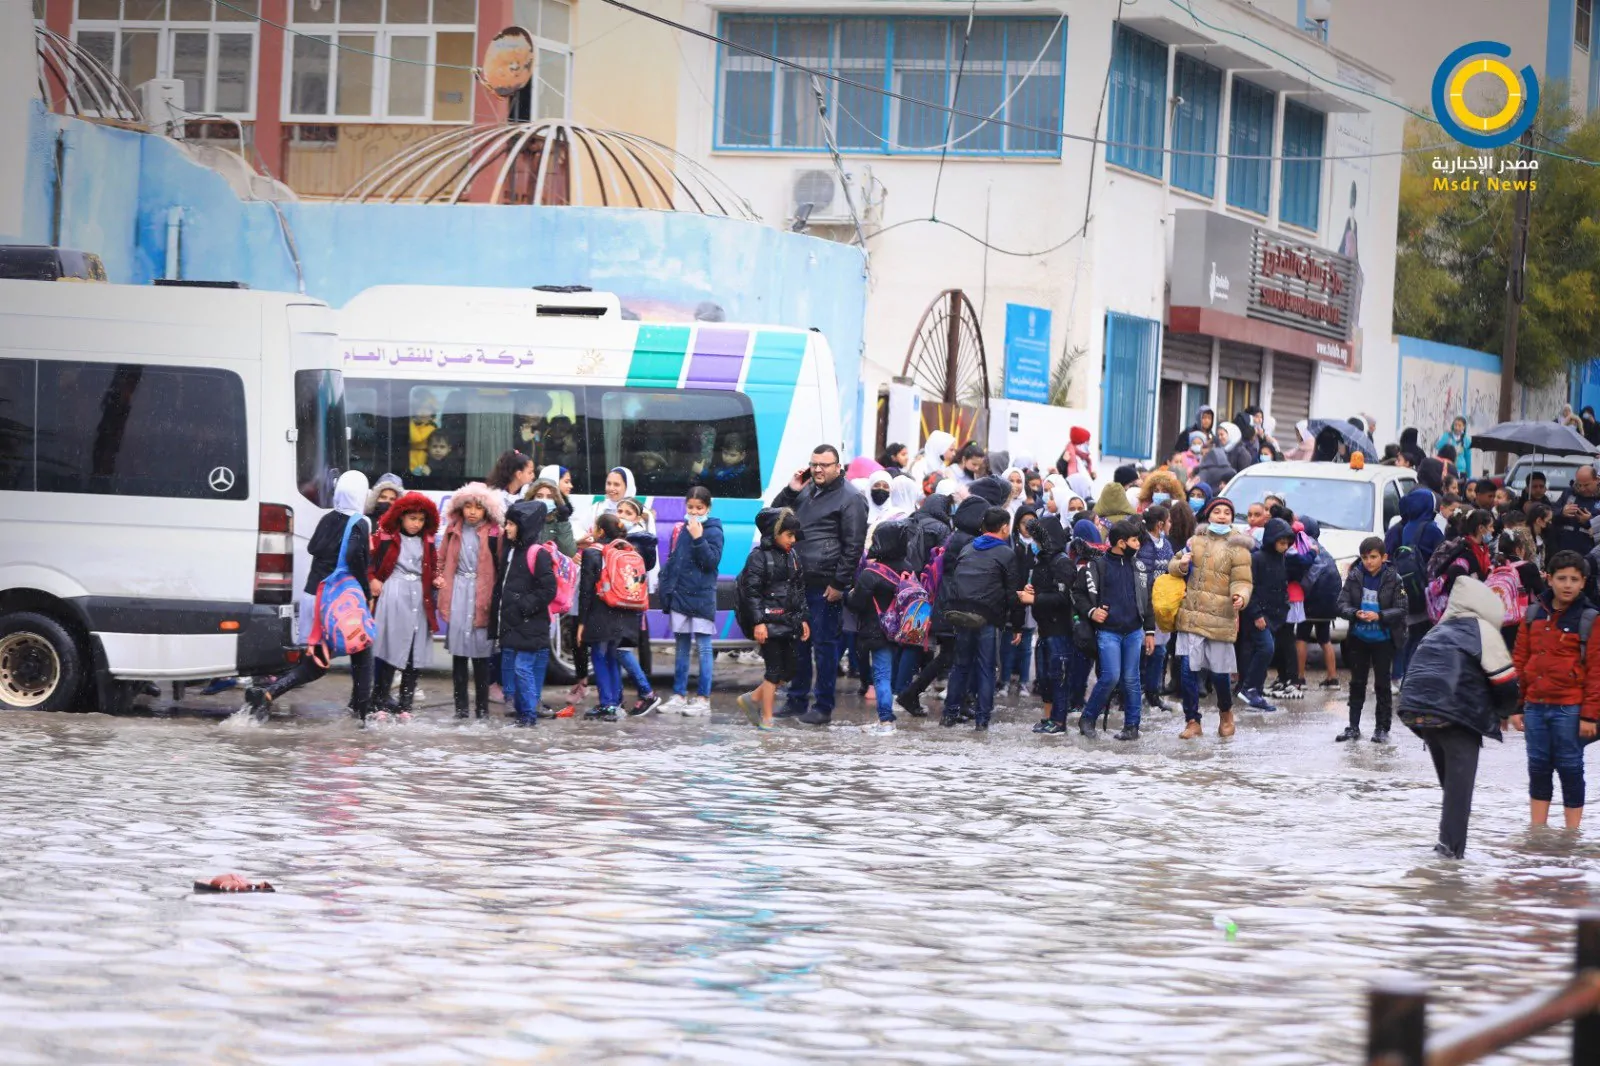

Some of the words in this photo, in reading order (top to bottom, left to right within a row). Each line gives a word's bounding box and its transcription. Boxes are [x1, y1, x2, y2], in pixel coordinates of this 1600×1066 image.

[343, 346, 386, 365] العام
[389, 347, 433, 366] للنقل
[476, 348, 534, 369] شركة
